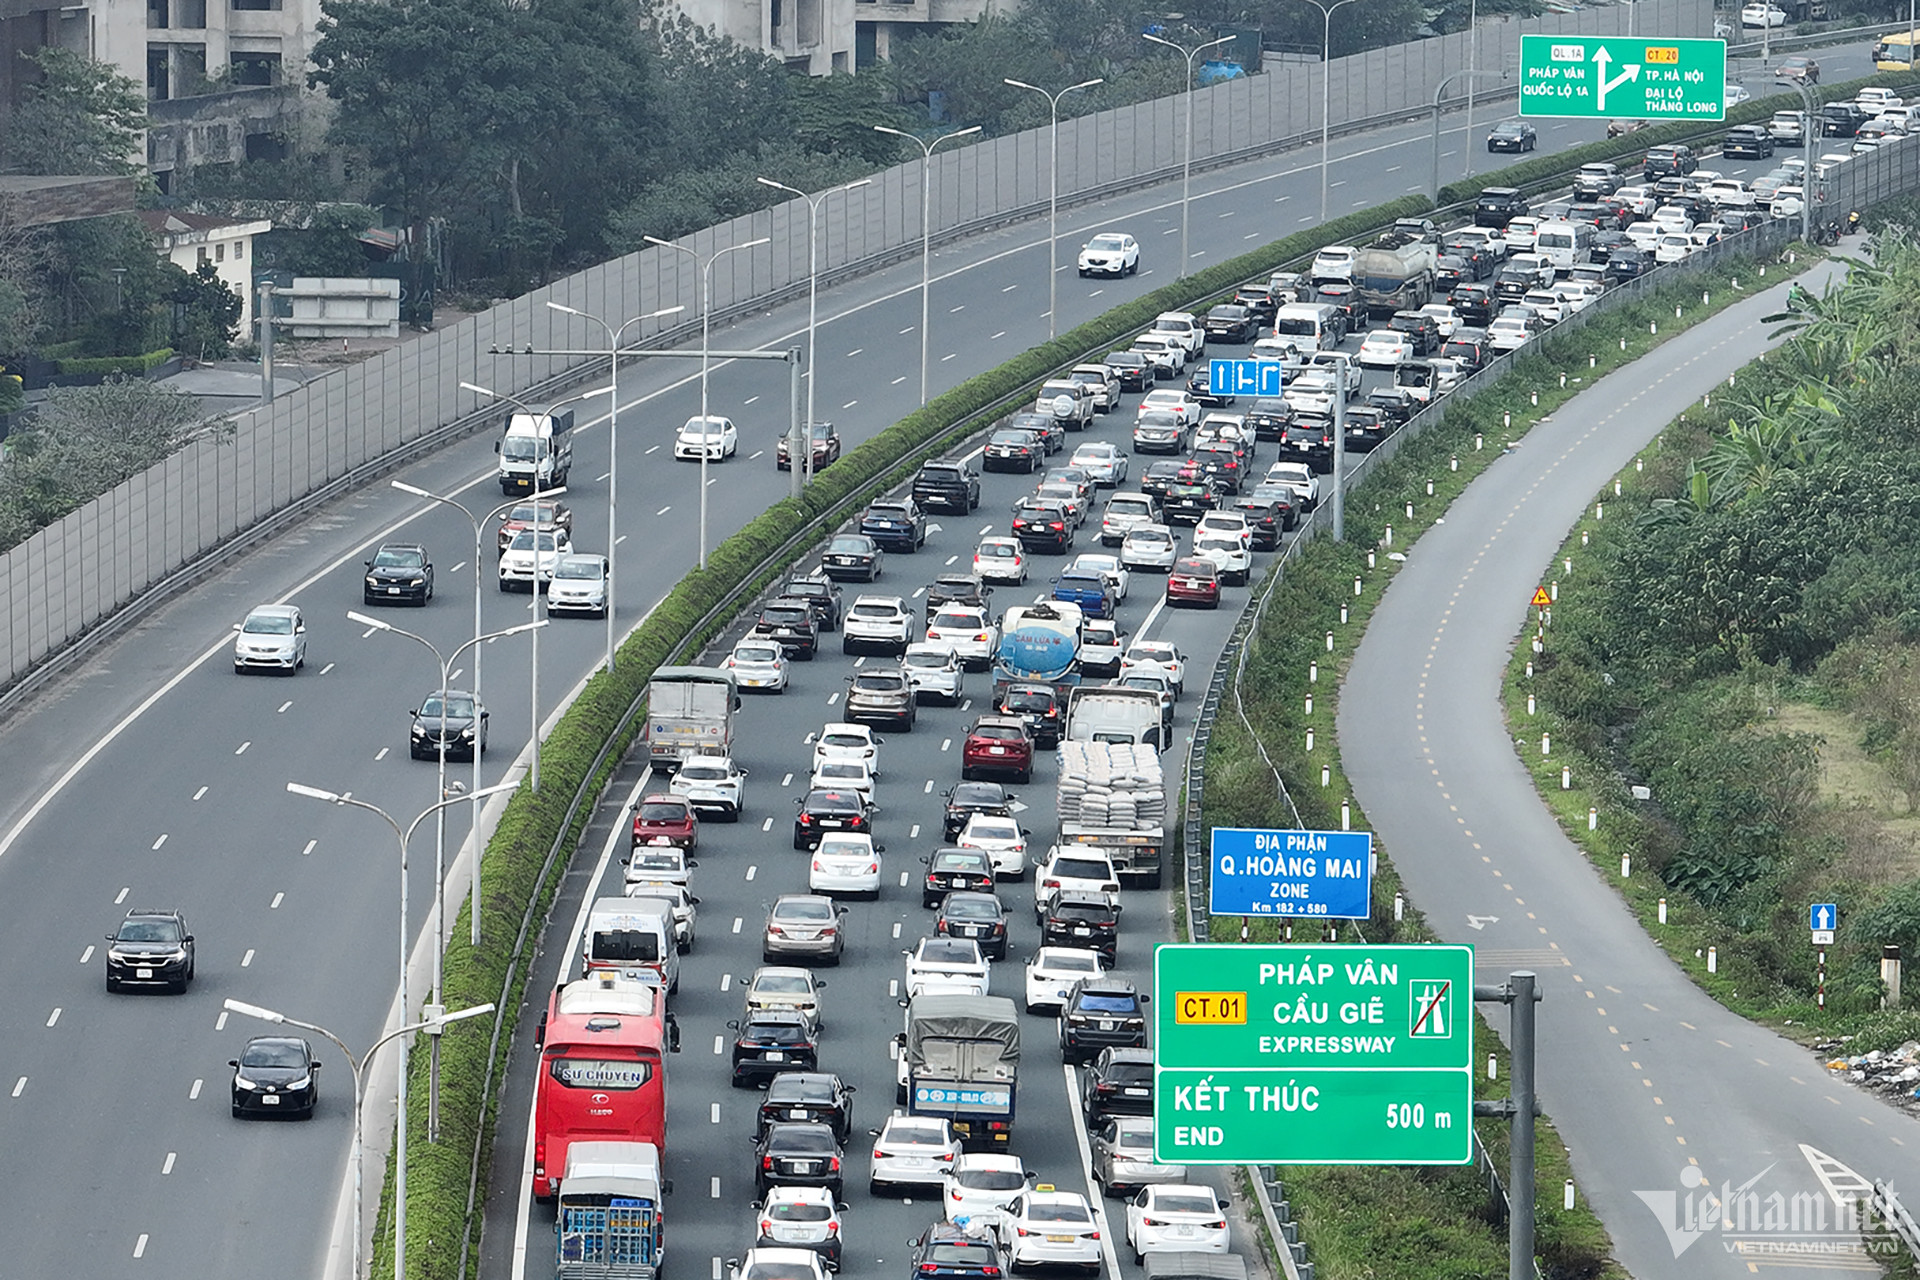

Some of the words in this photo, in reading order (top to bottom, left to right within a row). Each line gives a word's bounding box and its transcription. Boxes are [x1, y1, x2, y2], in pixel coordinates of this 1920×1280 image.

[1554, 48, 1582, 58] QL.1A
[1648, 50, 1677, 61] CT.20
[1530, 66, 1559, 78] PHÁP
[1564, 67, 1584, 78] VÂN
[1685, 70, 1703, 84] NỘI
[1523, 82, 1553, 95] QUỐC
[1558, 84, 1572, 98] LỘ
[1576, 87, 1588, 95] 1A
[1645, 88, 1665, 100] ĐẠI
[1669, 86, 1683, 100] LỘ
[1687, 102, 1716, 112] LONG
[1255, 834, 1280, 853] ĐỊA
[1287, 832, 1327, 854] PHẬN
[1325, 859, 1361, 879] MAI
[1270, 883, 1308, 898] ZONE
[1252, 902, 1271, 912] Km
[1276, 903, 1293, 912] 182
[1308, 904, 1327, 913] 580
[1260, 955, 1333, 984] PHÁP
[1345, 959, 1397, 984] VÂN
[1185, 998, 1238, 1018] CT.01
[1274, 993, 1327, 1023] CẦU
[1340, 997, 1383, 1024] GIẼ
[1260, 1037, 1395, 1053] EXPRESSWAY
[1175, 1075, 1230, 1111] KẾT
[1244, 1080, 1319, 1111] THÚC
[1387, 1103, 1424, 1128] 500
[1435, 1113, 1450, 1128] m
[1175, 1127, 1223, 1145] END
